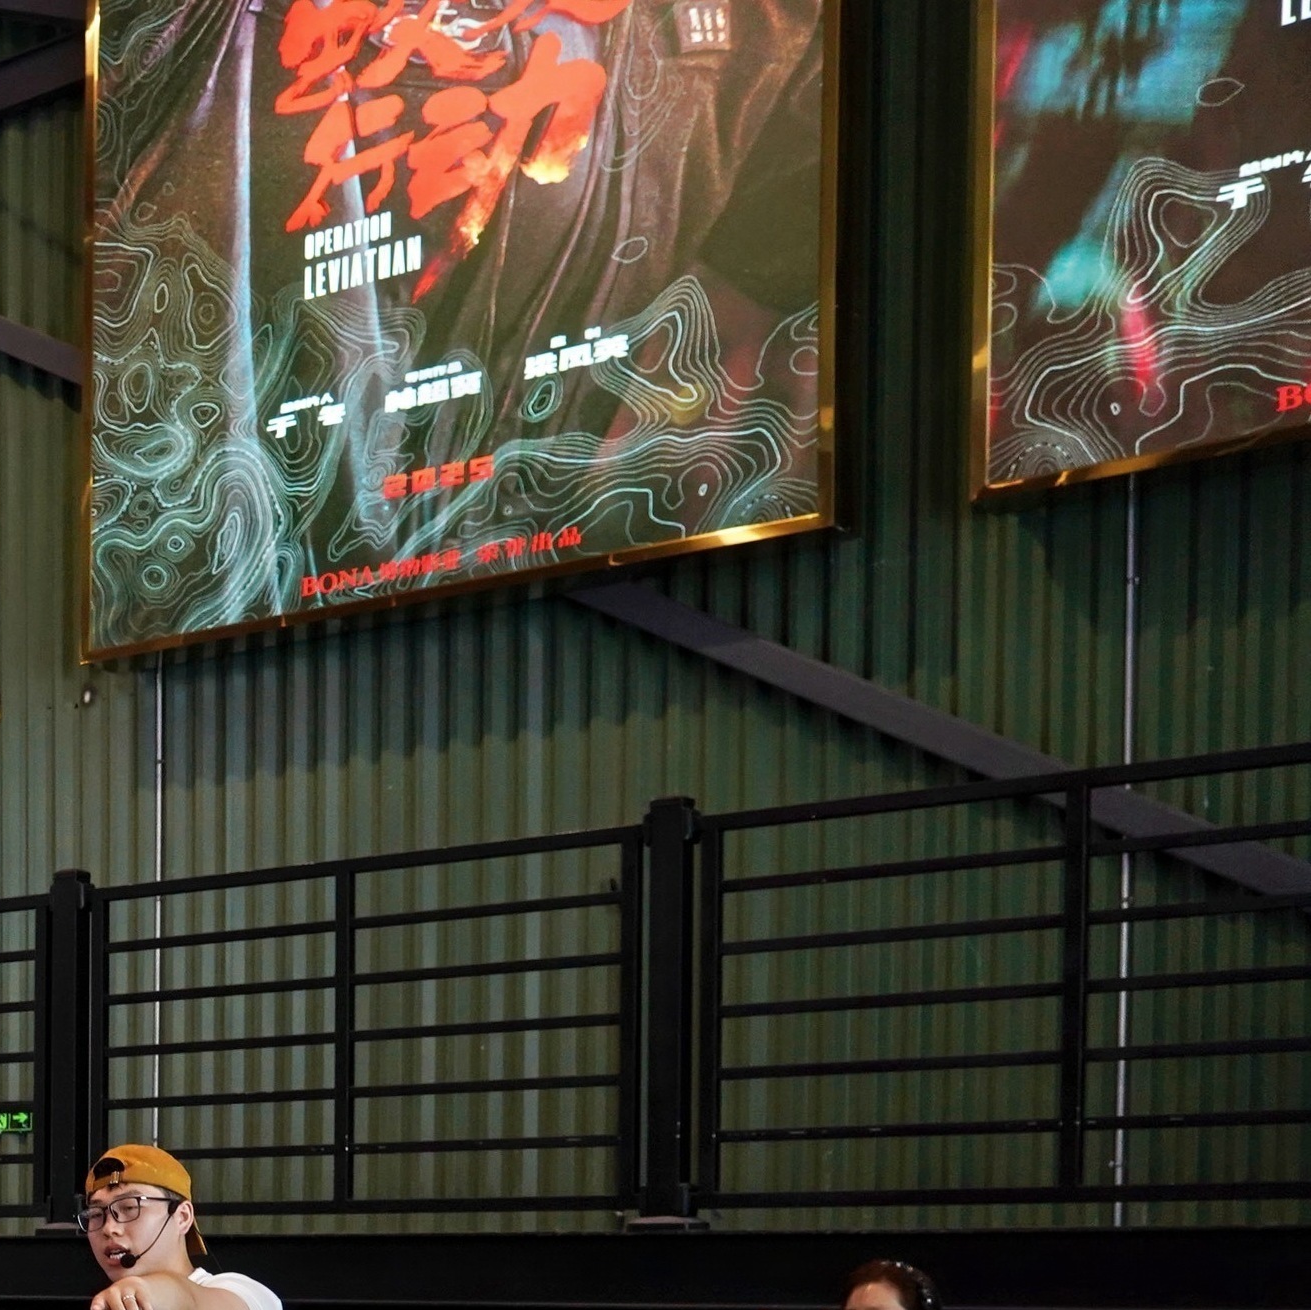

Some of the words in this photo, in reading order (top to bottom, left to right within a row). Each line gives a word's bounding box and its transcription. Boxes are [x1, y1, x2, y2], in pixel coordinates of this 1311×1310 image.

[304, 211, 392, 260] OPERATION
[304, 235, 422, 300] LEVIATHAN
[383, 455, 494, 499] 2025
[301, 565, 374, 597] BONA
